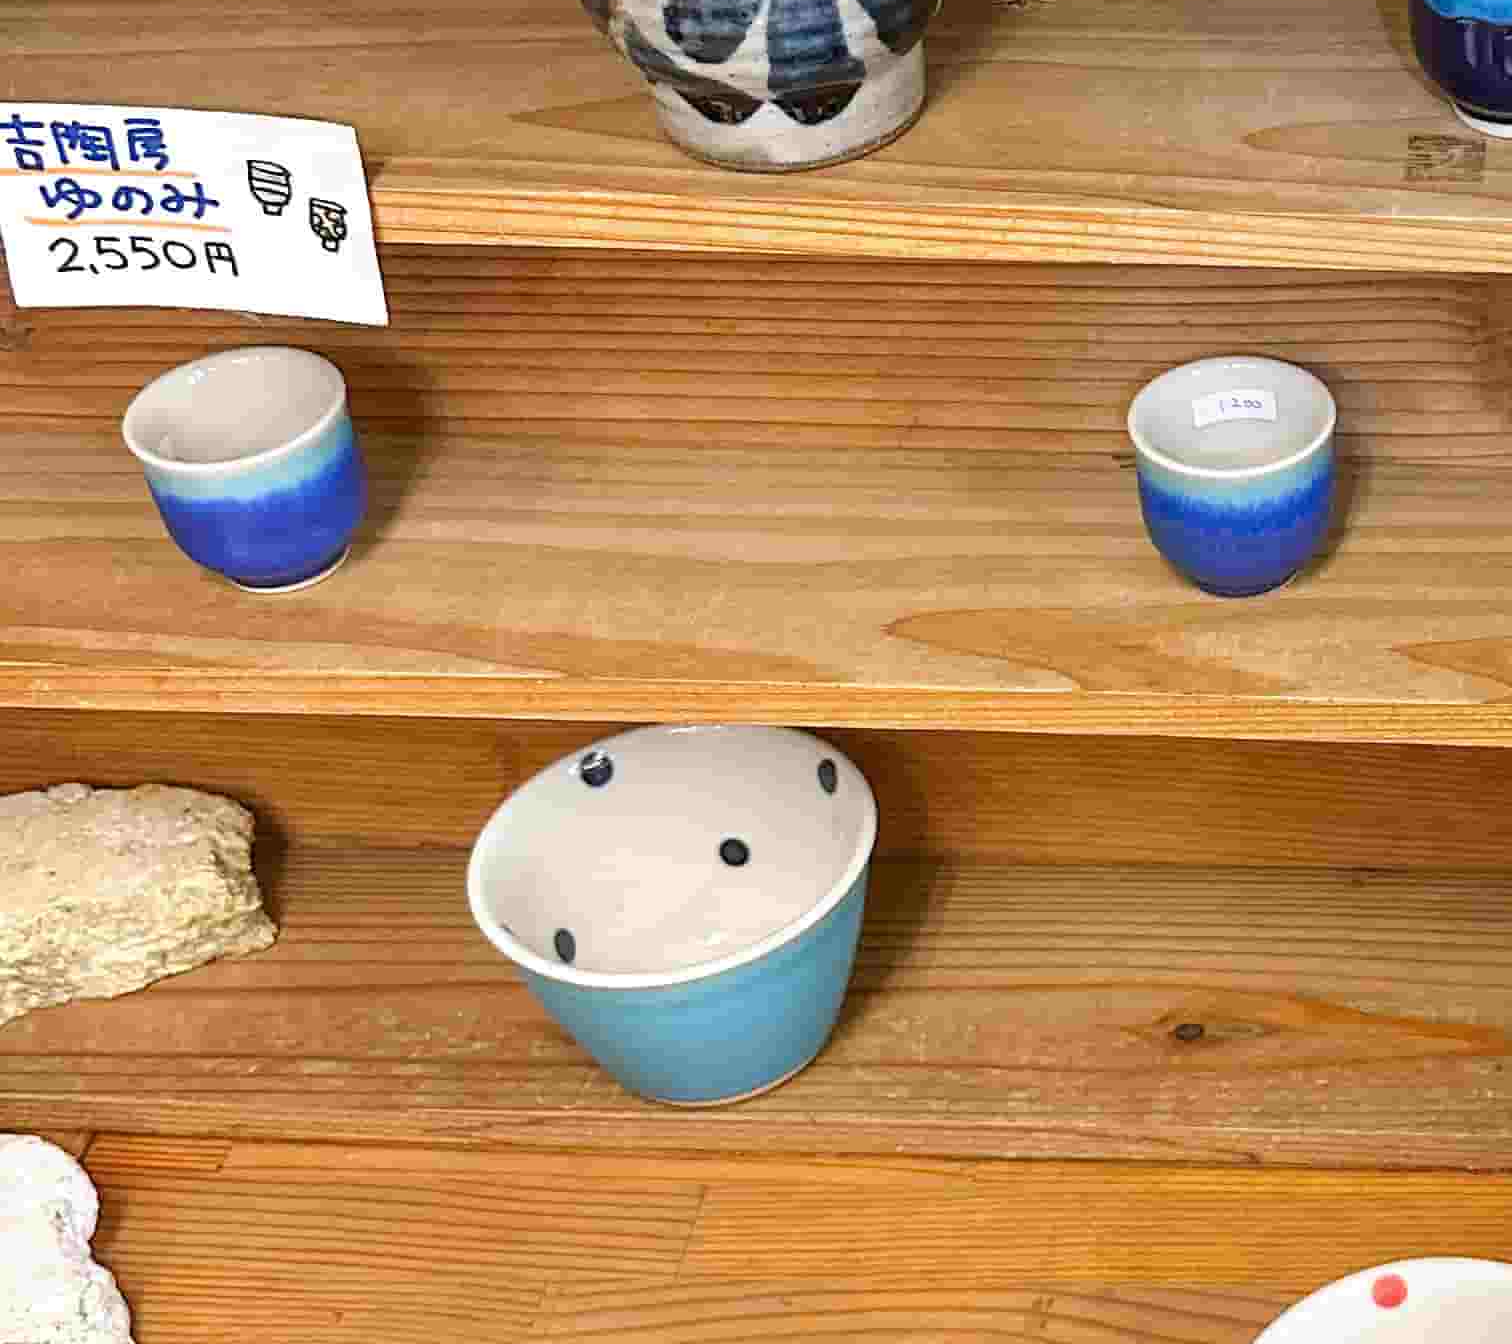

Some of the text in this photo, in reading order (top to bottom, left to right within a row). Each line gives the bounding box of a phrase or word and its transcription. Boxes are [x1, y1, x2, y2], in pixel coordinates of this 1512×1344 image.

[39, 177, 220, 220] ゆのみ
[48, 236, 240, 277] 2,550円
